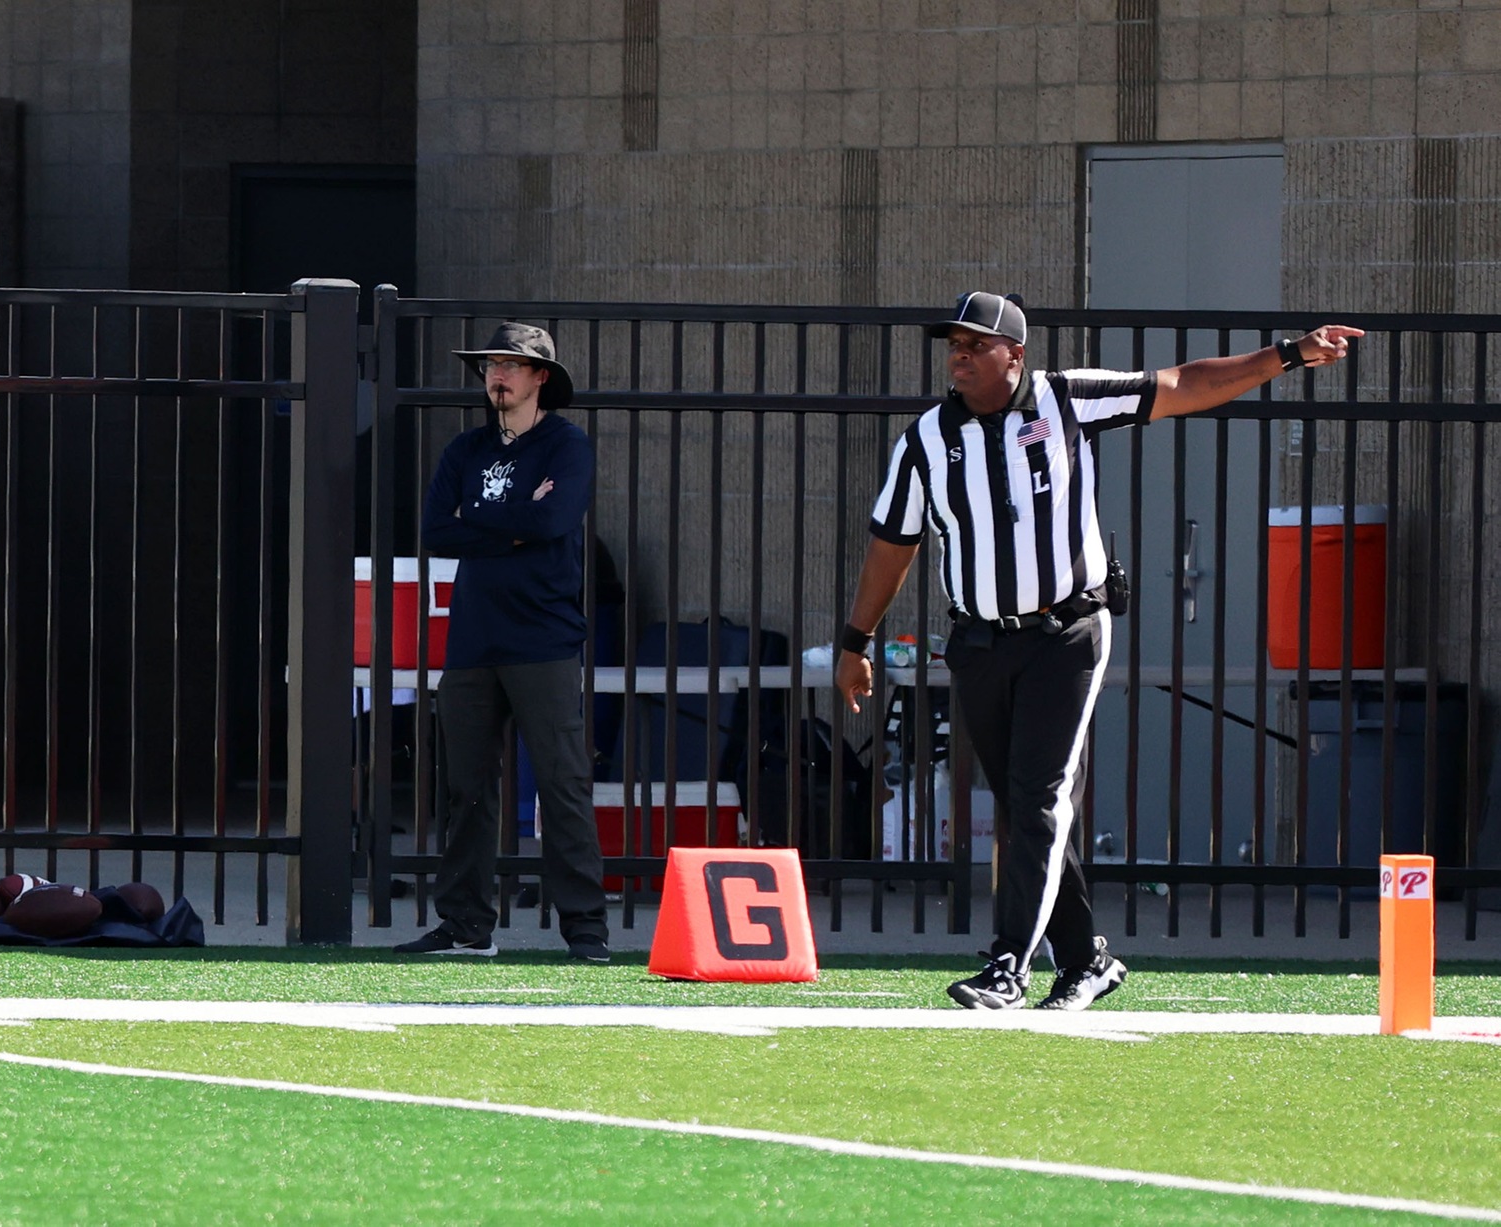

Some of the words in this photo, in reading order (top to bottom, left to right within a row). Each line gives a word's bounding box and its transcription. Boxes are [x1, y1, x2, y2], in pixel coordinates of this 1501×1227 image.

[1033, 470, 1050, 494] L
[1400, 870, 1428, 896] P
[702, 860, 789, 961] G
